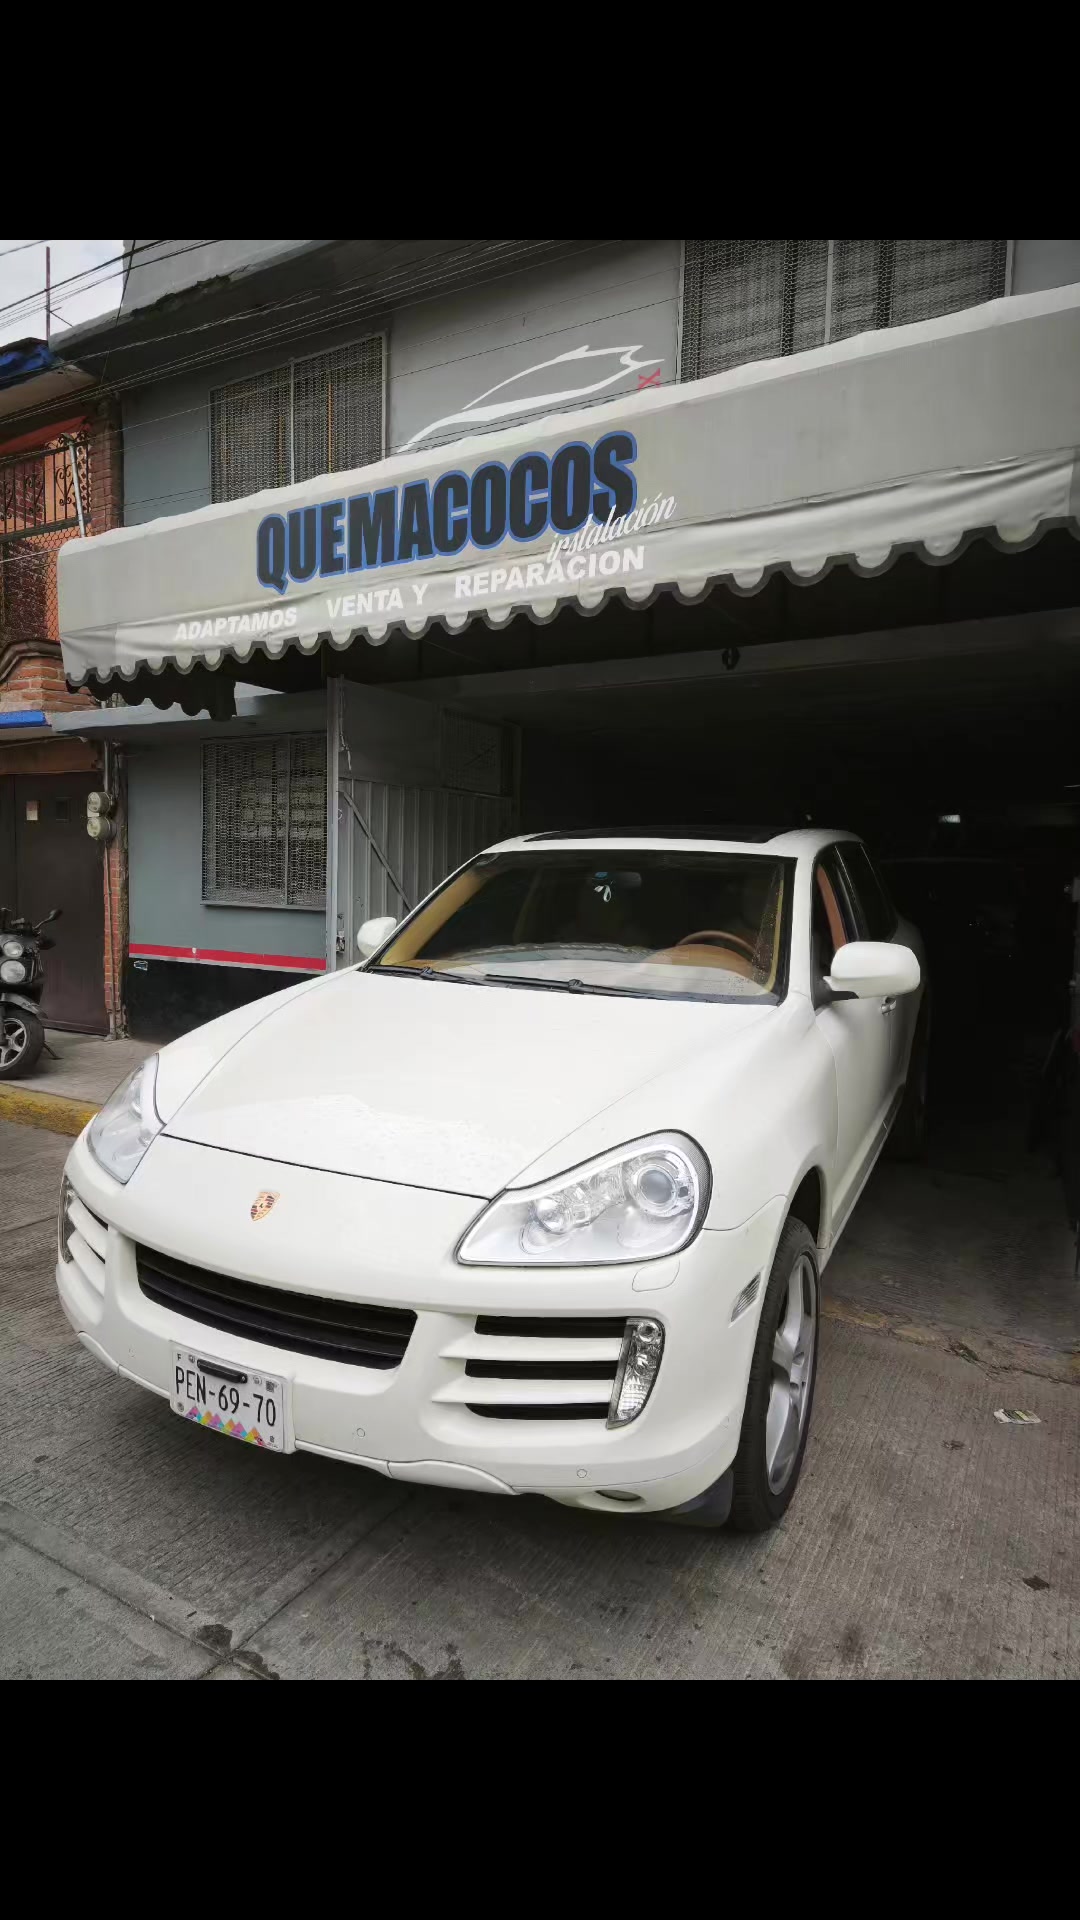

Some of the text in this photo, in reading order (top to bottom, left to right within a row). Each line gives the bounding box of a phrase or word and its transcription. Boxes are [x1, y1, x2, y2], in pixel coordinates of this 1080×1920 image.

[256, 431, 637, 595] QUEMACOCOS
[174, 545, 645, 642] ADAPTAMOS VENTA Y REPARACION
[175, 1365, 276, 1427] PEN-69-70
